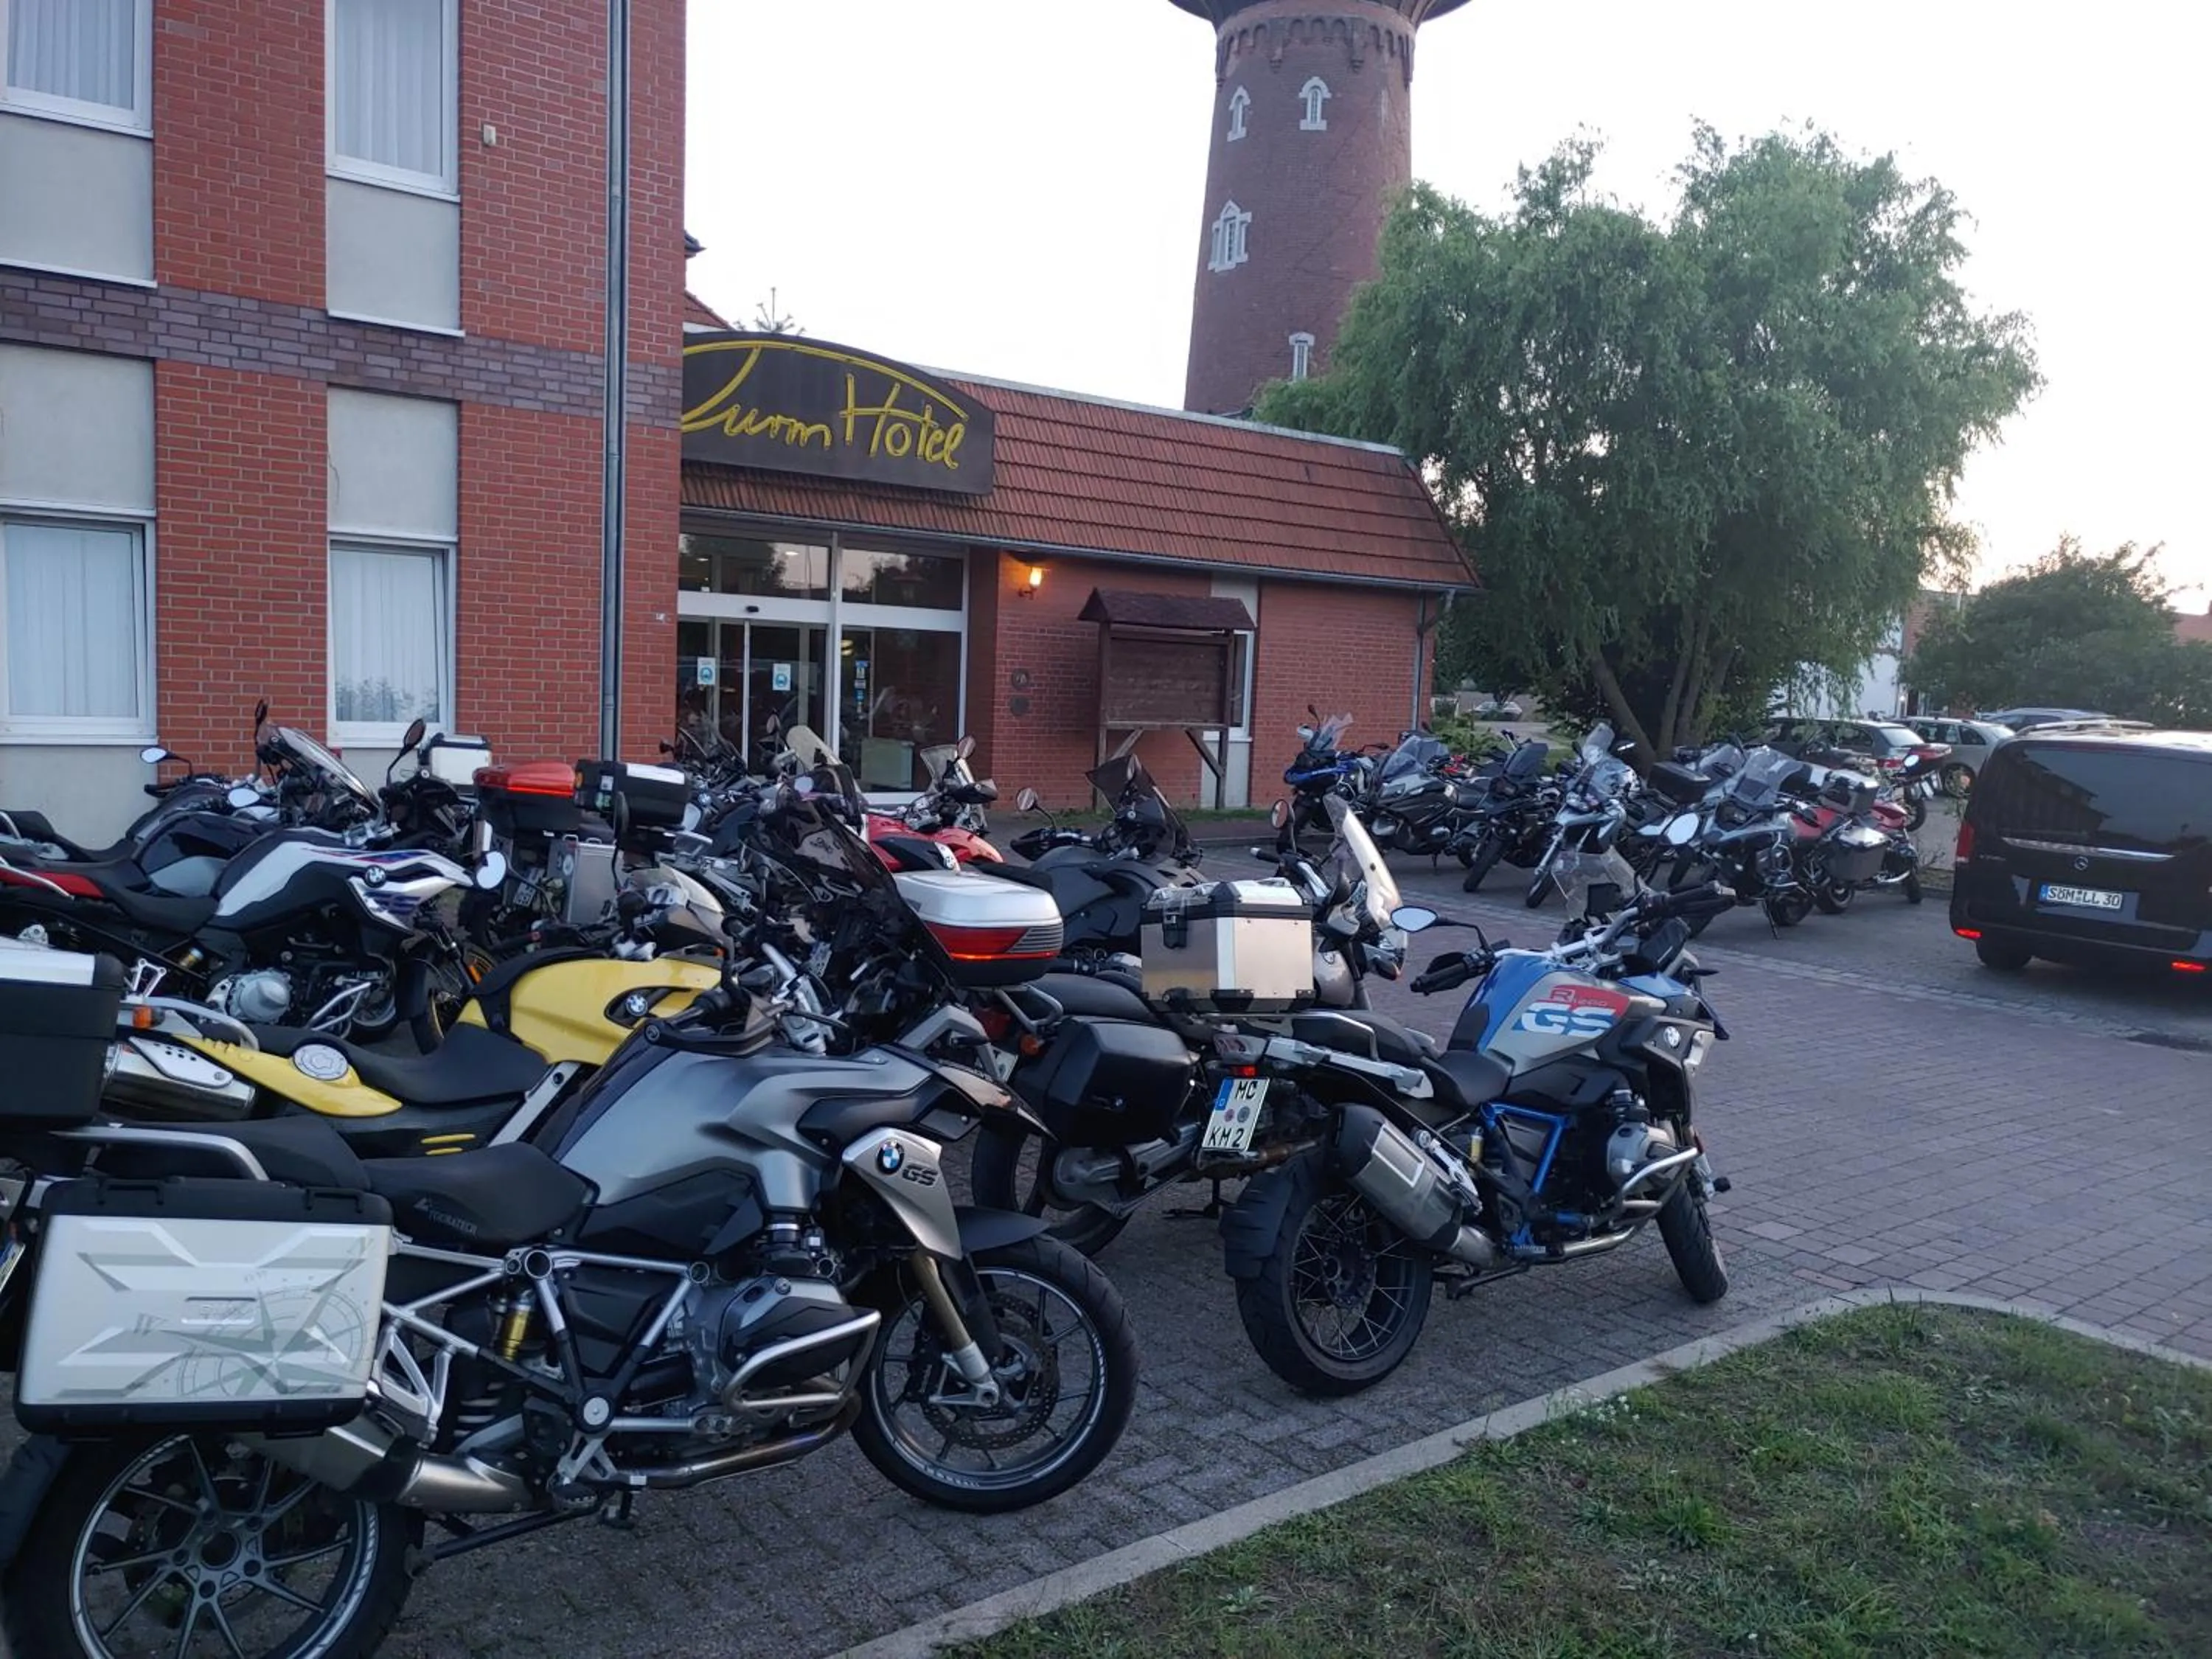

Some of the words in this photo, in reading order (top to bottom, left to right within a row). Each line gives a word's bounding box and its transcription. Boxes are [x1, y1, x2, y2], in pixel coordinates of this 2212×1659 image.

[839, 372, 967, 469] Hotel
[2082, 891, 2101, 904] LL
[2102, 894, 2120, 906] 30
[1521, 1001, 1616, 1037] GS
[1235, 1080, 1258, 1099] MC
[1208, 1126, 1232, 1147] KM
[1232, 1127, 1245, 1147] 2
[902, 1164, 939, 1186] GS
